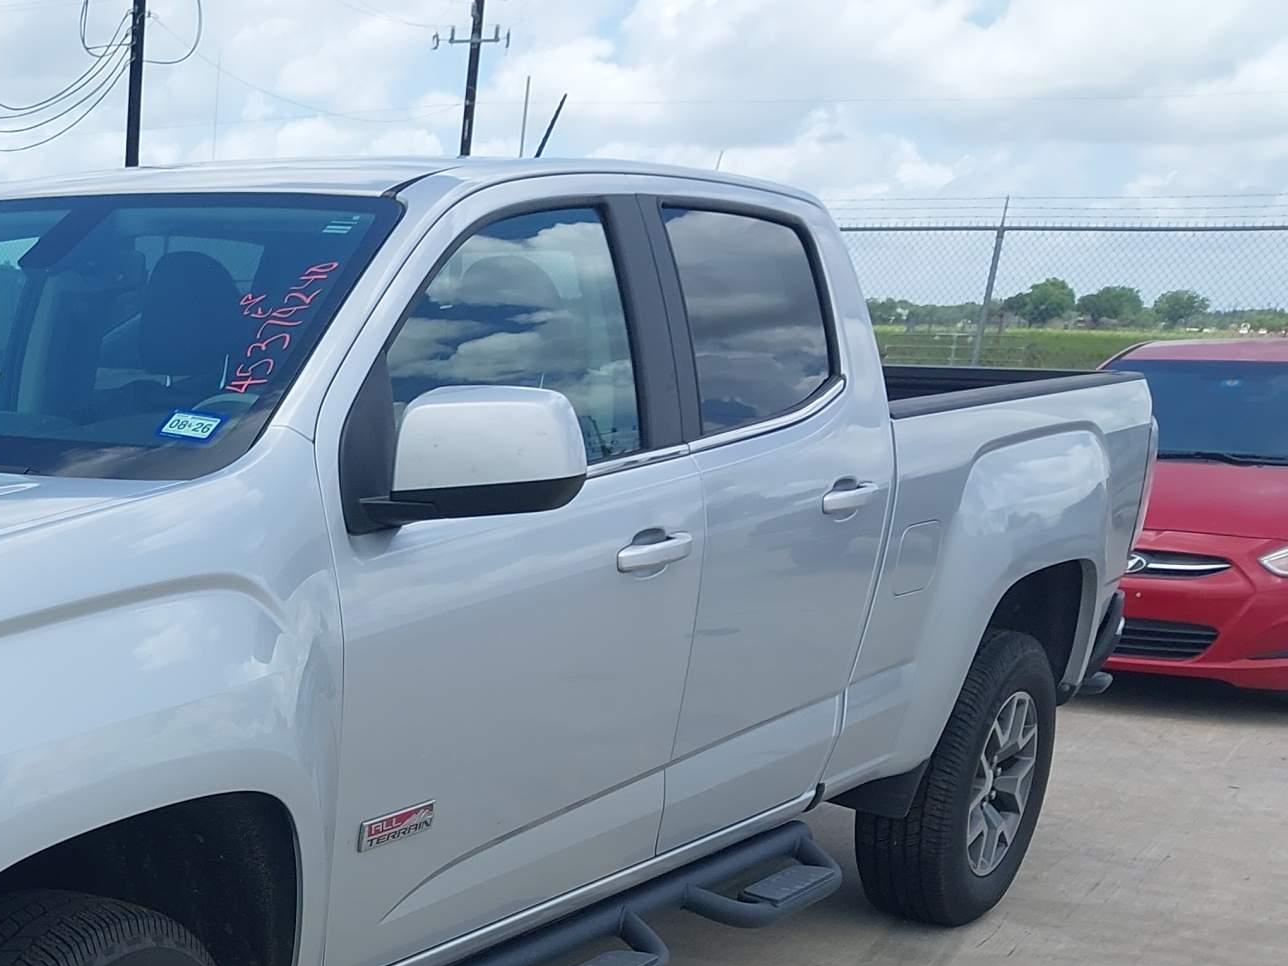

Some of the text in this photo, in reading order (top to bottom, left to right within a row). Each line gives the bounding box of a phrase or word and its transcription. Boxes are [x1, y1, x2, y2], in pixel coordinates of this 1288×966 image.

[168, 418, 214, 434] 08 26
[367, 817, 433, 847] TERRAIN
[371, 818, 403, 835] ALL
